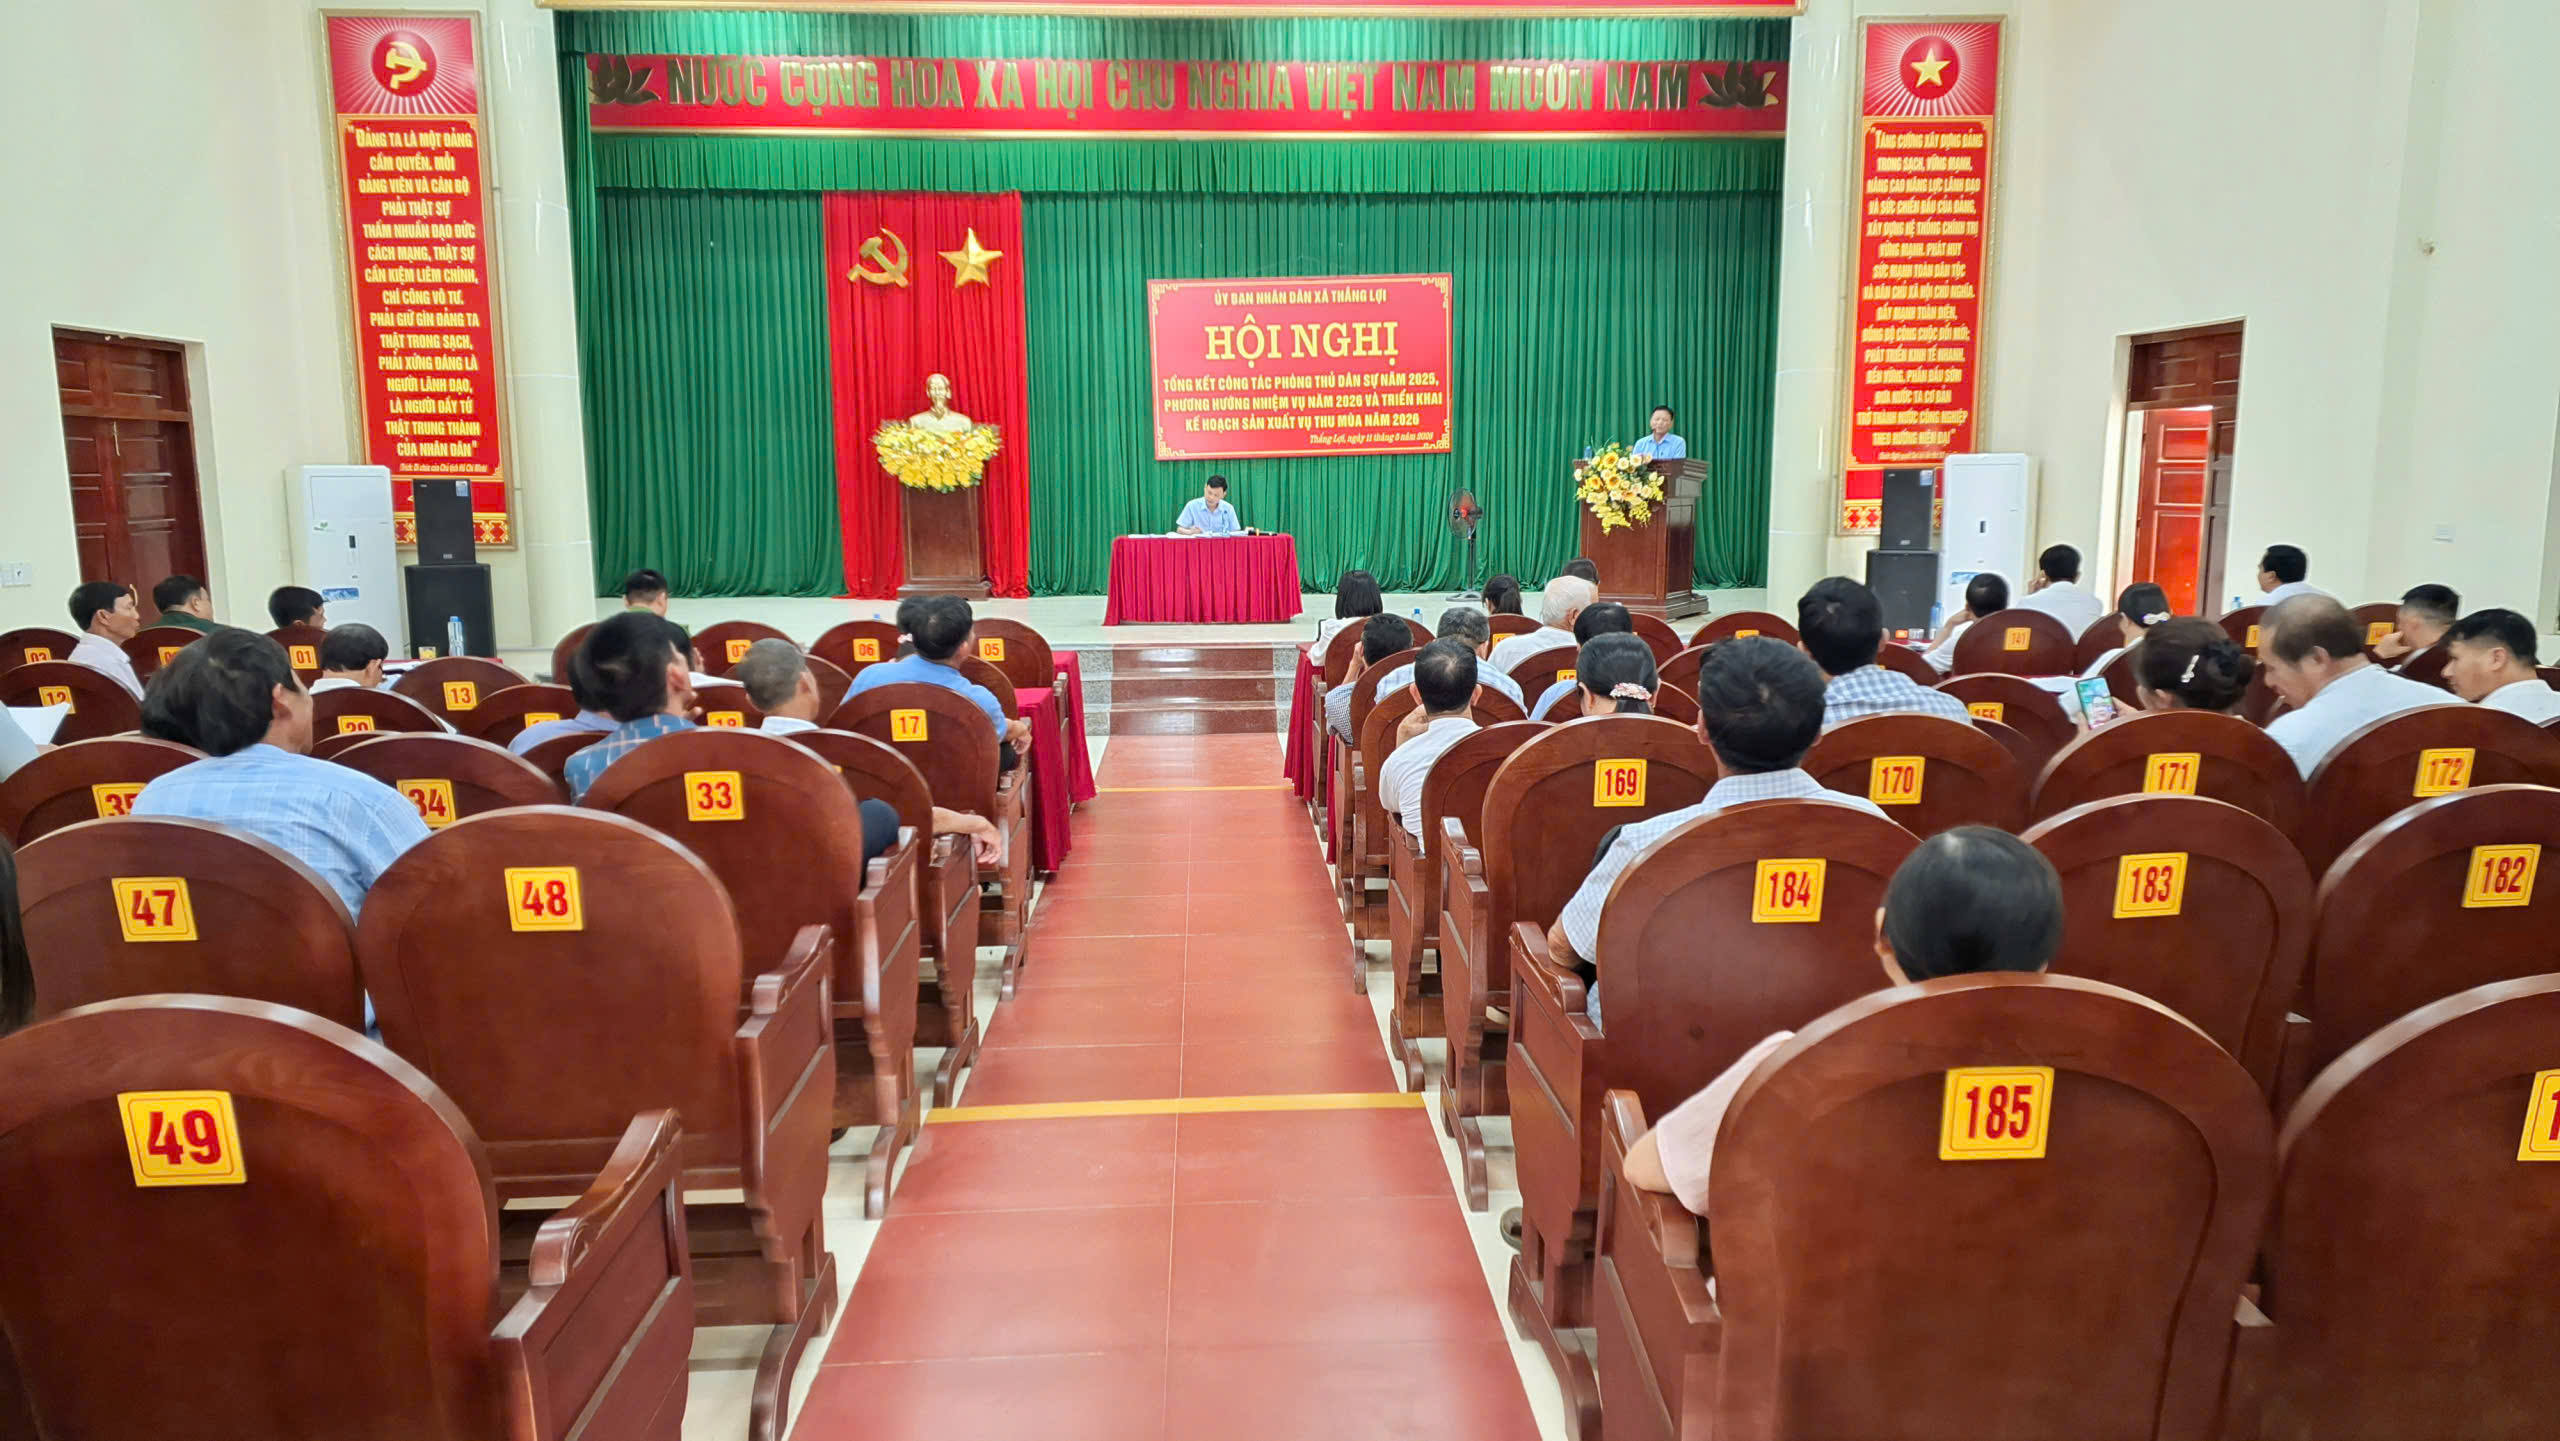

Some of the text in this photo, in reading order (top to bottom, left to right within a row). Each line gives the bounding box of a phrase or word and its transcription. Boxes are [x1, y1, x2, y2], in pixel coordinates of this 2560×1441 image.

[1392, 64, 1476, 111] NAM
[389, 132, 402, 147] TA
[403, 129, 418, 148] LÀ
[1231, 292, 1254, 305] BAN
[1256, 290, 1288, 305] NHÂN
[1289, 289, 1312, 304] DÂN
[1314, 289, 1329, 304] XÃ
[1368, 289, 1387, 305] LỢI
[406, 334, 441, 349] TRONG
[1204, 313, 1399, 368] HỘI NGHỊ
[1195, 373, 1215, 392] KẾT
[1218, 375, 1249, 391] CÔNG
[1251, 373, 1272, 390] TÁC
[1274, 373, 1313, 389] PHÒNG
[1315, 371, 1336, 388] THỦ
[1338, 372, 1361, 388] DÂN
[1363, 372, 1380, 389] SỰ
[1381, 371, 1406, 387] NĂM
[1408, 372, 1440, 387] 2025,
[1164, 396, 1210, 412] PHƯƠNG
[1212, 395, 1250, 411] HƯỚNG
[1252, 394, 1289, 412] NHIỆM
[1291, 396, 1306, 411] VỤ
[1308, 393, 1334, 408] NĂM
[1365, 392, 1380, 407] VÀ
[1416, 391, 1443, 406] KHAI
[411, 421, 446, 435] TRUNG
[1202, 417, 1240, 434] HOẠCH
[1241, 413, 1265, 431] SẢN
[1267, 412, 1296, 430] XUẤT
[1297, 415, 1312, 431] VỤ
[1314, 415, 1335, 429] THU
[1337, 412, 1362, 428] MÙA
[1364, 412, 1390, 427] NĂM
[296, 650, 313, 664] 01
[858, 643, 874, 656] 06
[984, 643, 1000, 656] 05
[450, 687, 472, 705] 13
[899, 716, 919, 735] 17
[1604, 767, 1638, 797] 169
[1882, 766, 1914, 796] 170
[2158, 762, 2189, 790] 171
[2431, 758, 2463, 786] 172
[408, 788, 446, 817] 34
[696, 782, 732, 810] 33
[2131, 865, 2173, 903] 183
[2483, 856, 2526, 894] 182
[521, 880, 568, 917] 48
[1769, 871, 1811, 908] 184
[132, 889, 176, 927] 47
[1966, 1085, 2033, 1139] 185
[147, 1109, 222, 1165] 49
